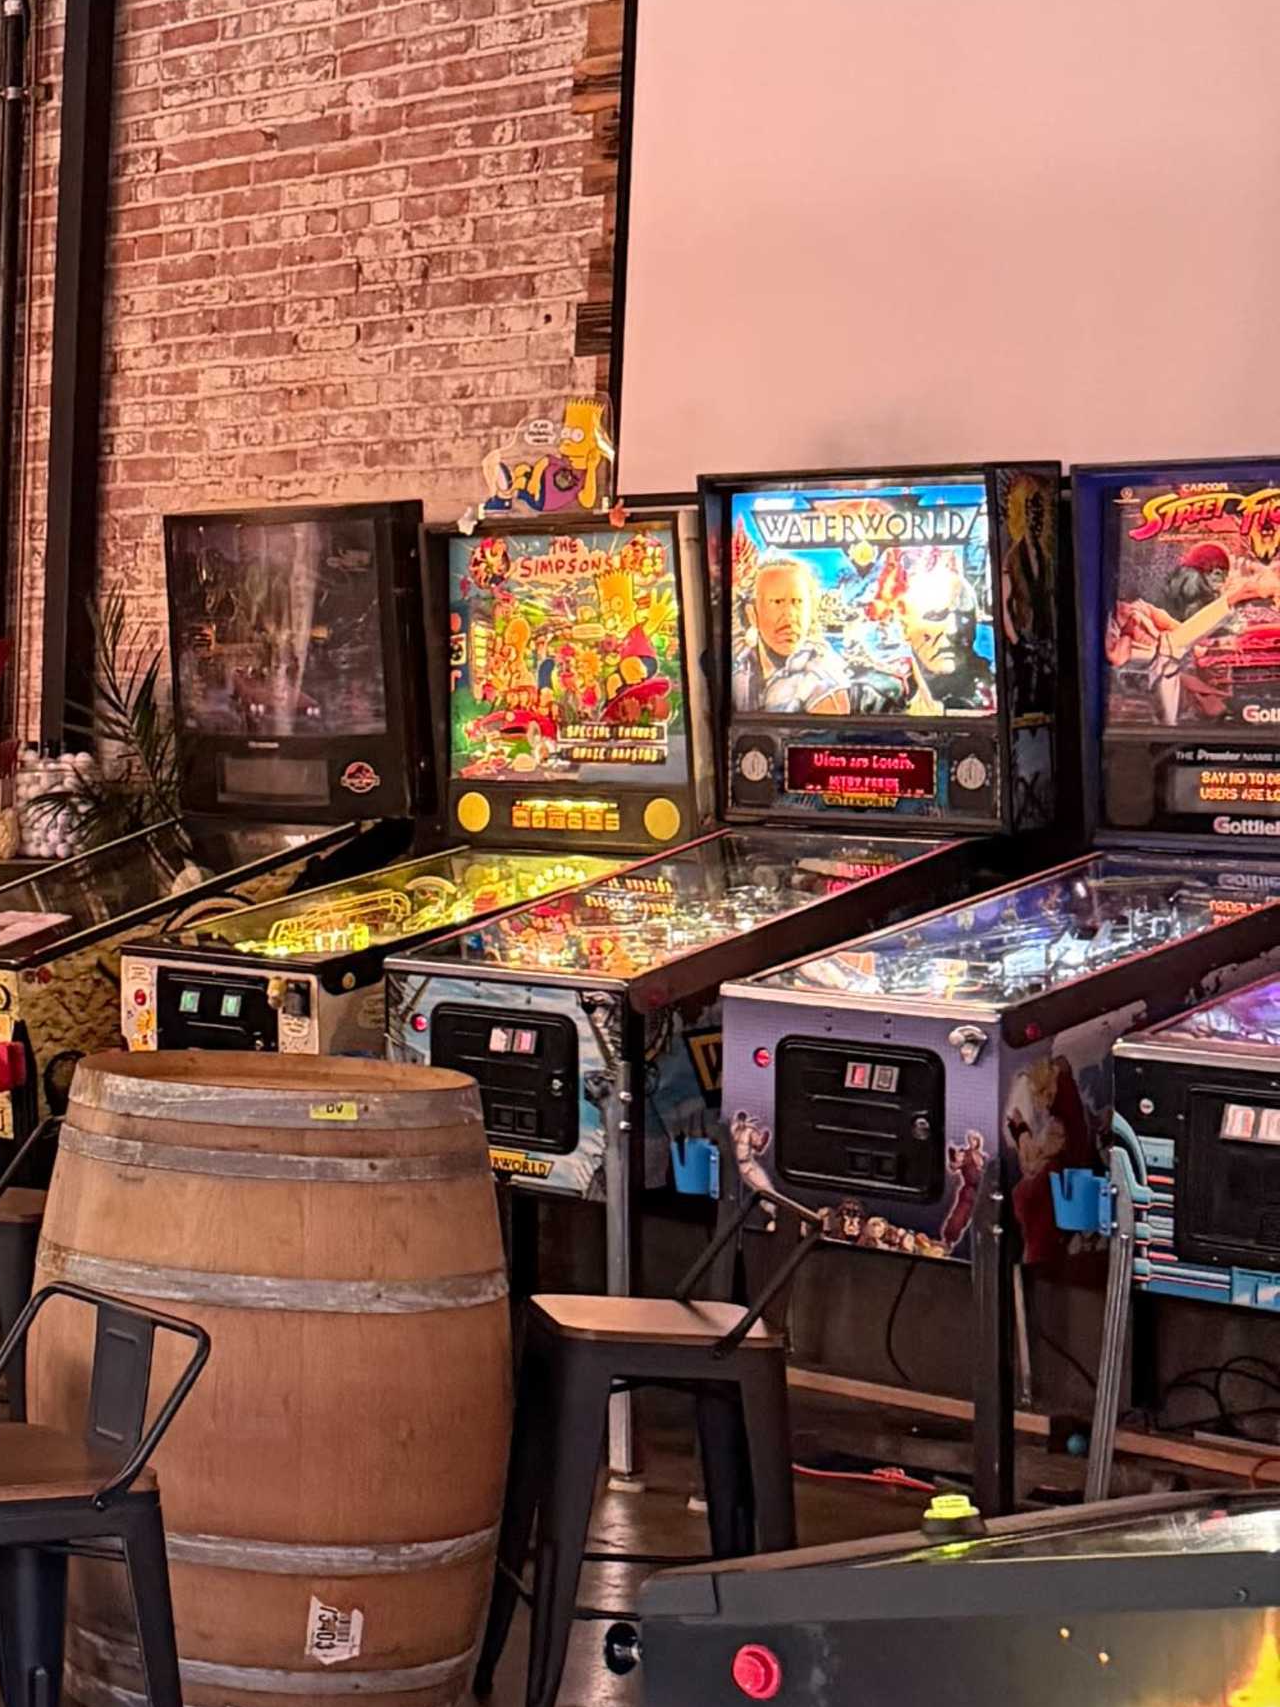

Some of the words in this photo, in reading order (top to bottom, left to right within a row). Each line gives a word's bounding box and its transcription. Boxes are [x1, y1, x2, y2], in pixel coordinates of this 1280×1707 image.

[1181, 482, 1229, 492] CAPCOM
[760, 511, 966, 542] WATERWORLD
[1128, 493, 1247, 541] STREET
[551, 536, 579, 555] THE
[519, 555, 614, 579] SIMPSONS
[1200, 771, 1228, 785] SAY
[1229, 772, 1247, 785] NO
[1248, 773, 1266, 786] TO
[1199, 787, 1239, 800] USERS
[492, 1156, 547, 1177] RWORLD
